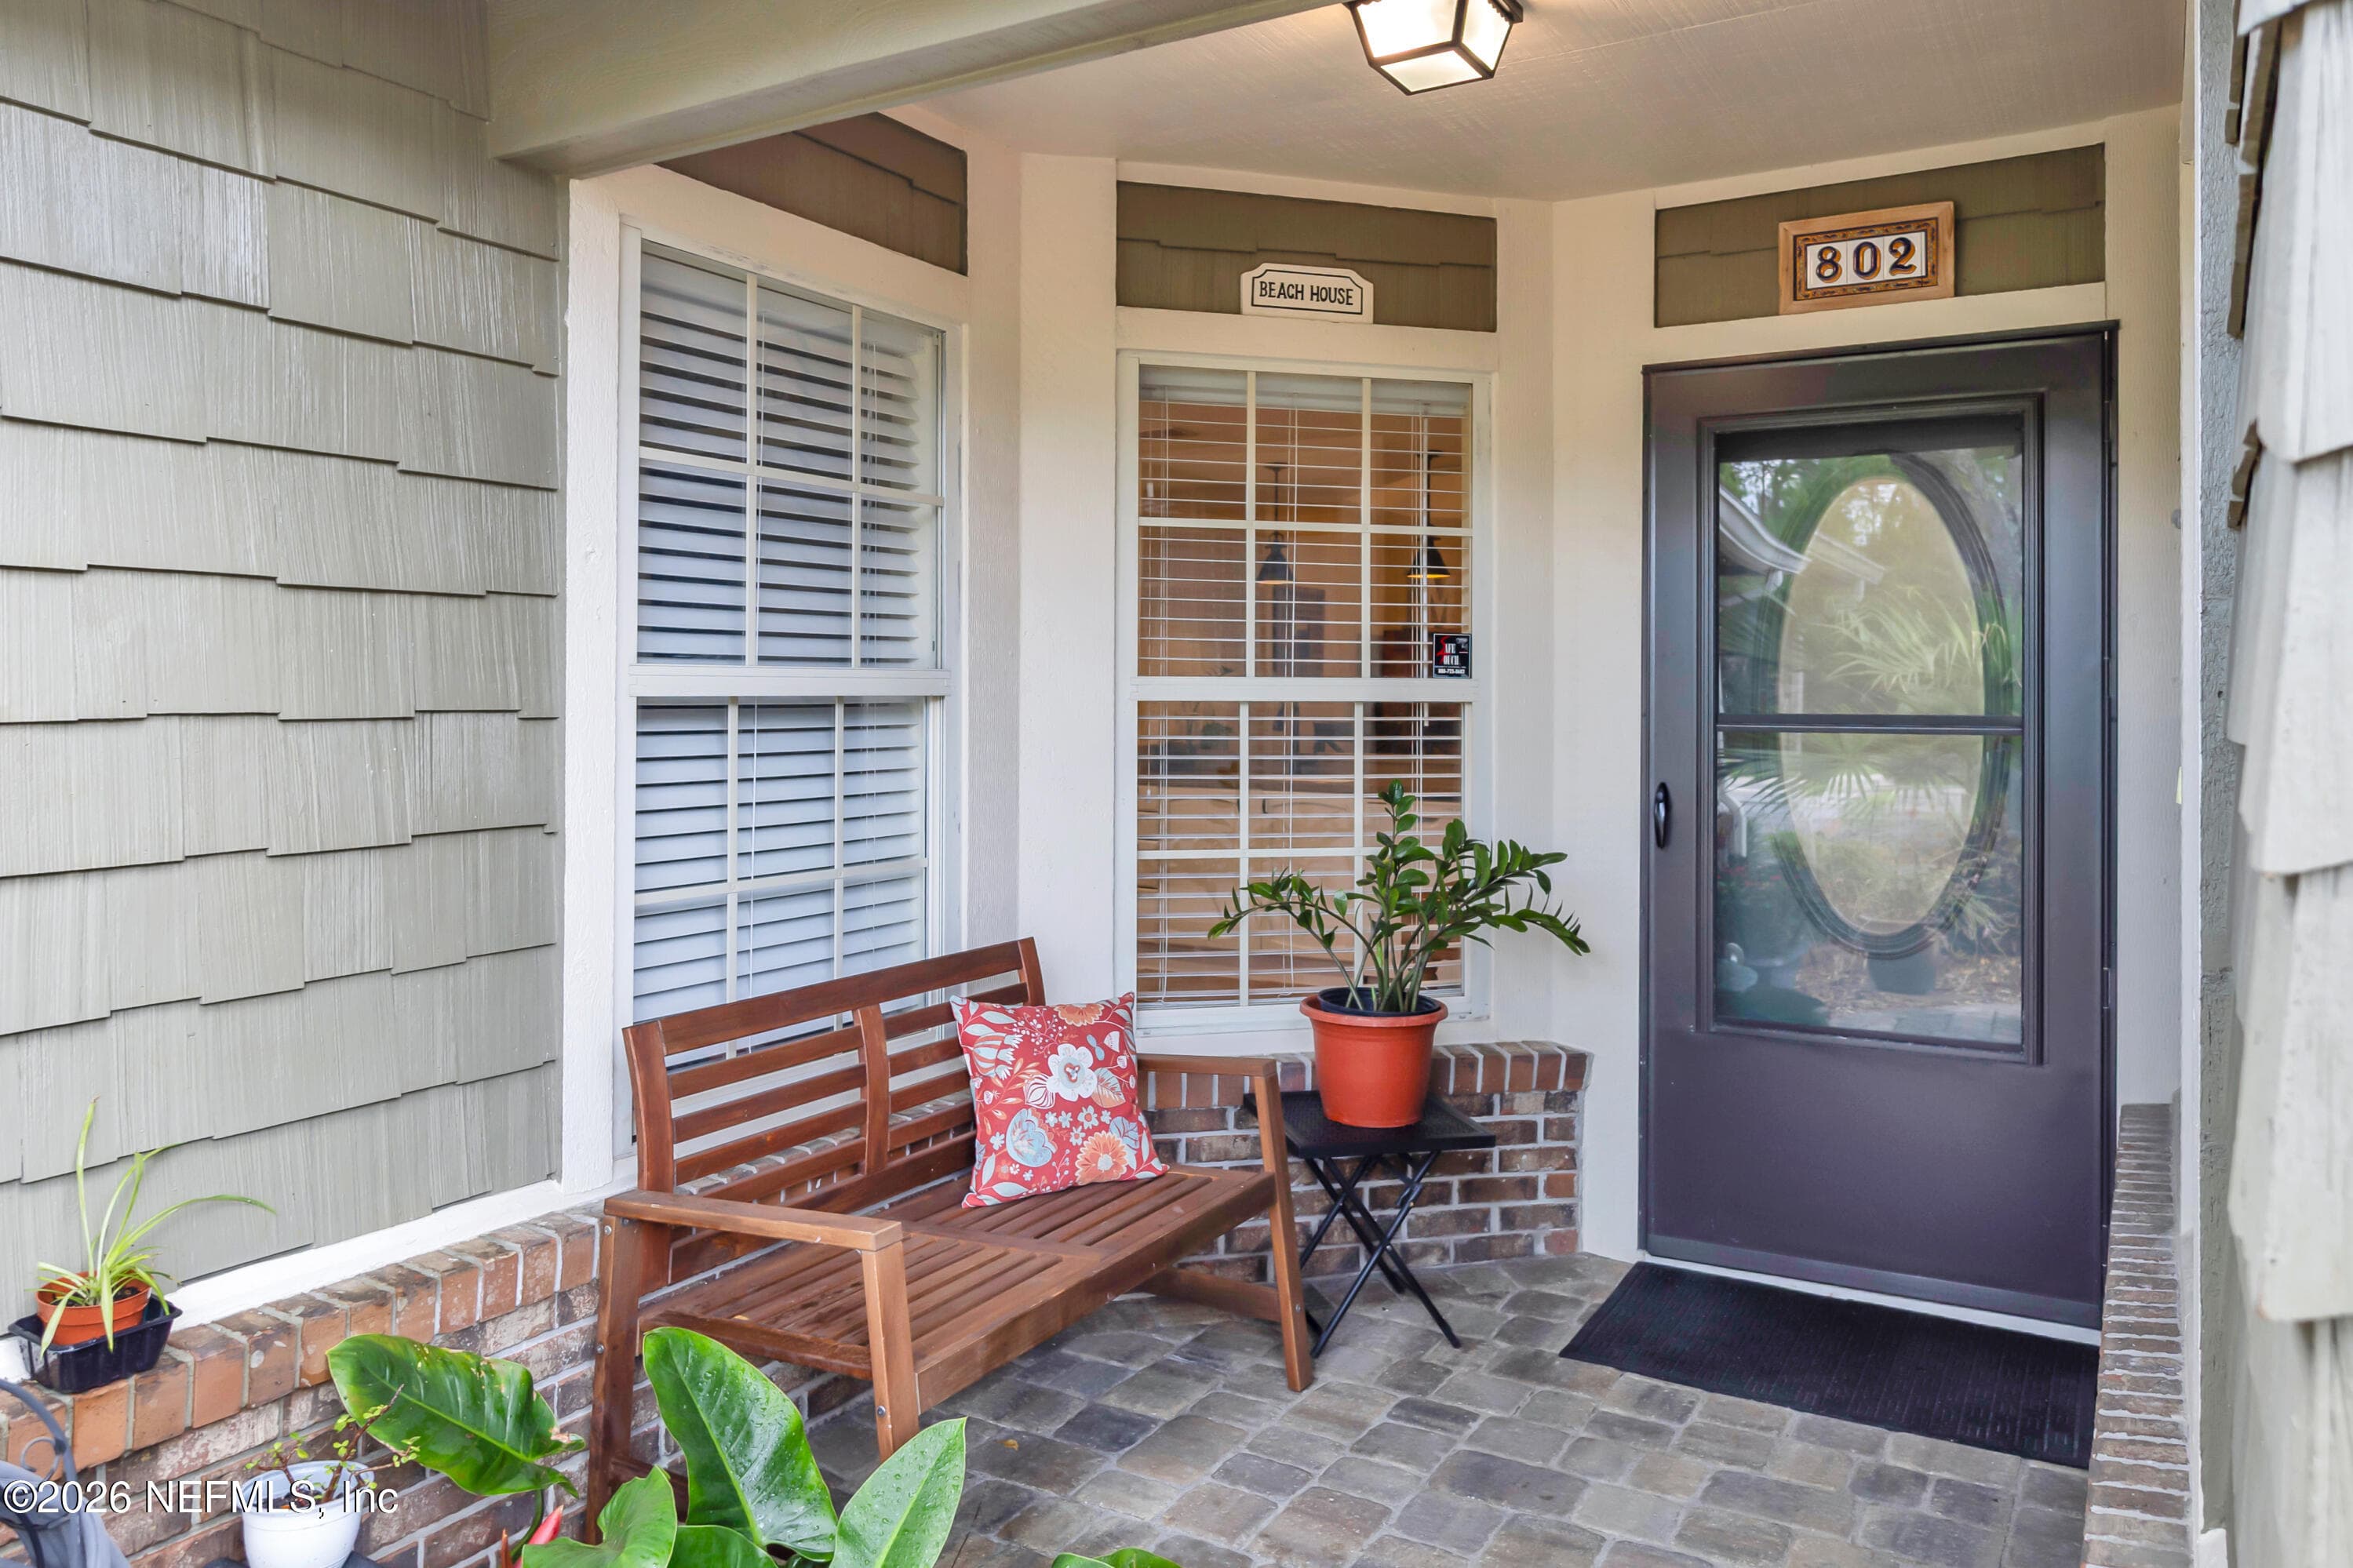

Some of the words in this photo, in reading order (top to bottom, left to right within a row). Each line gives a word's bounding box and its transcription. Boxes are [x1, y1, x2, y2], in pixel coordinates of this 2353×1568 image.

[1816, 236, 1917, 283] 802
[1259, 281, 1304, 300] BEACH
[1309, 285, 1353, 305] HOUSE
